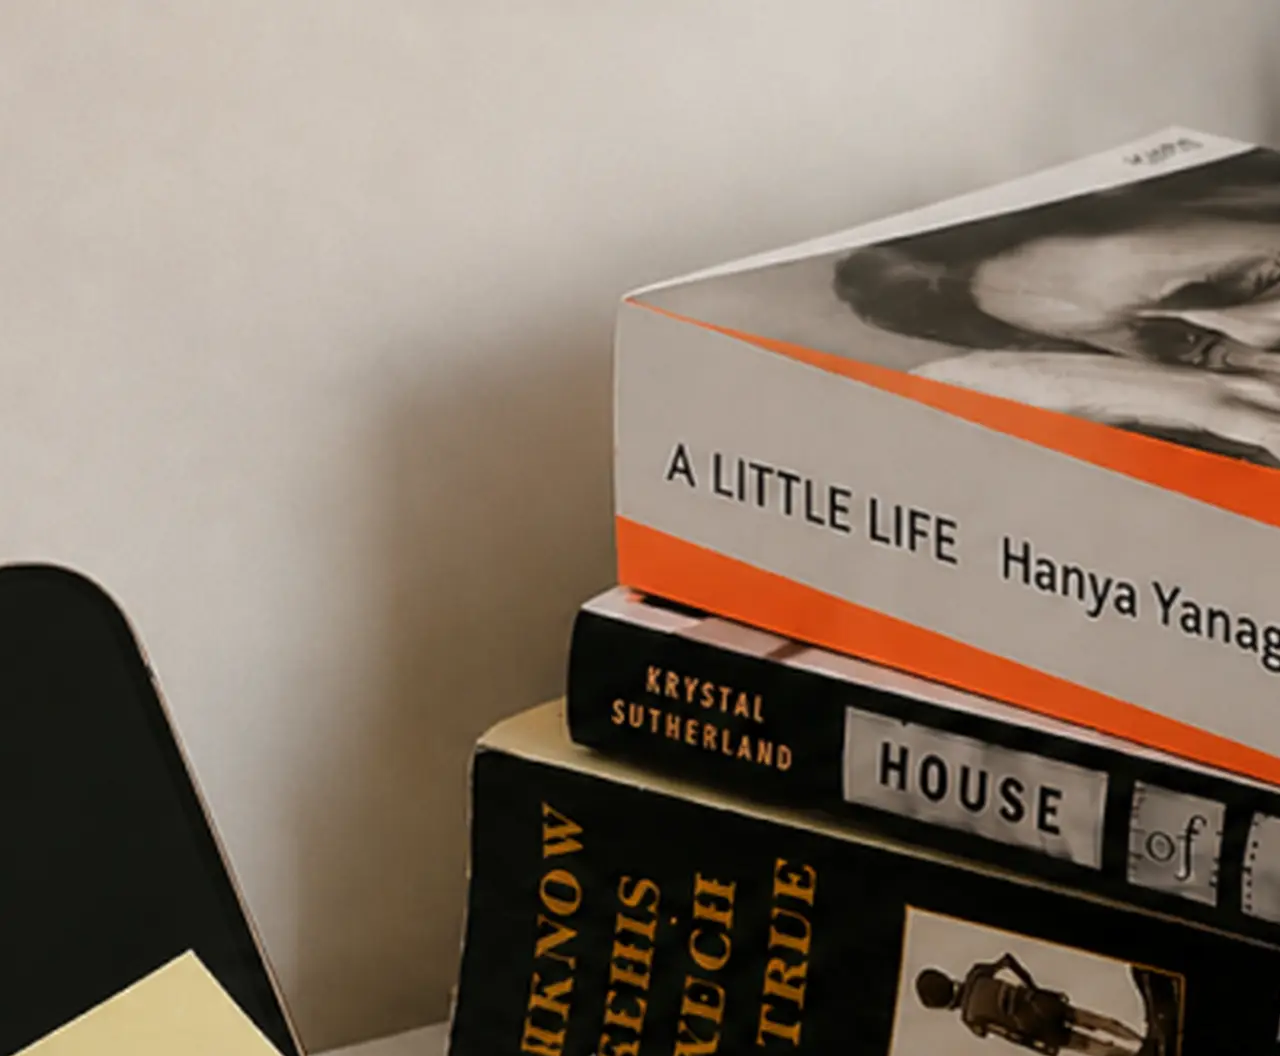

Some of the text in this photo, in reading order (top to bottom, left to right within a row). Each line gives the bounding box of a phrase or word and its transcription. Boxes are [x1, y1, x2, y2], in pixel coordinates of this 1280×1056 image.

[666, 443, 696, 487] A
[713, 453, 852, 533] LITTLE
[868, 497, 959, 565] LIFE
[1002, 537, 1137, 619] Hanya
[611, 699, 793, 771] SUTHERLAND
[645, 665, 764, 723] KRYSTAL
[879, 741, 1063, 835] HOUSE
[1145, 815, 1207, 882] of
[756, 858, 817, 1047] TRUE
